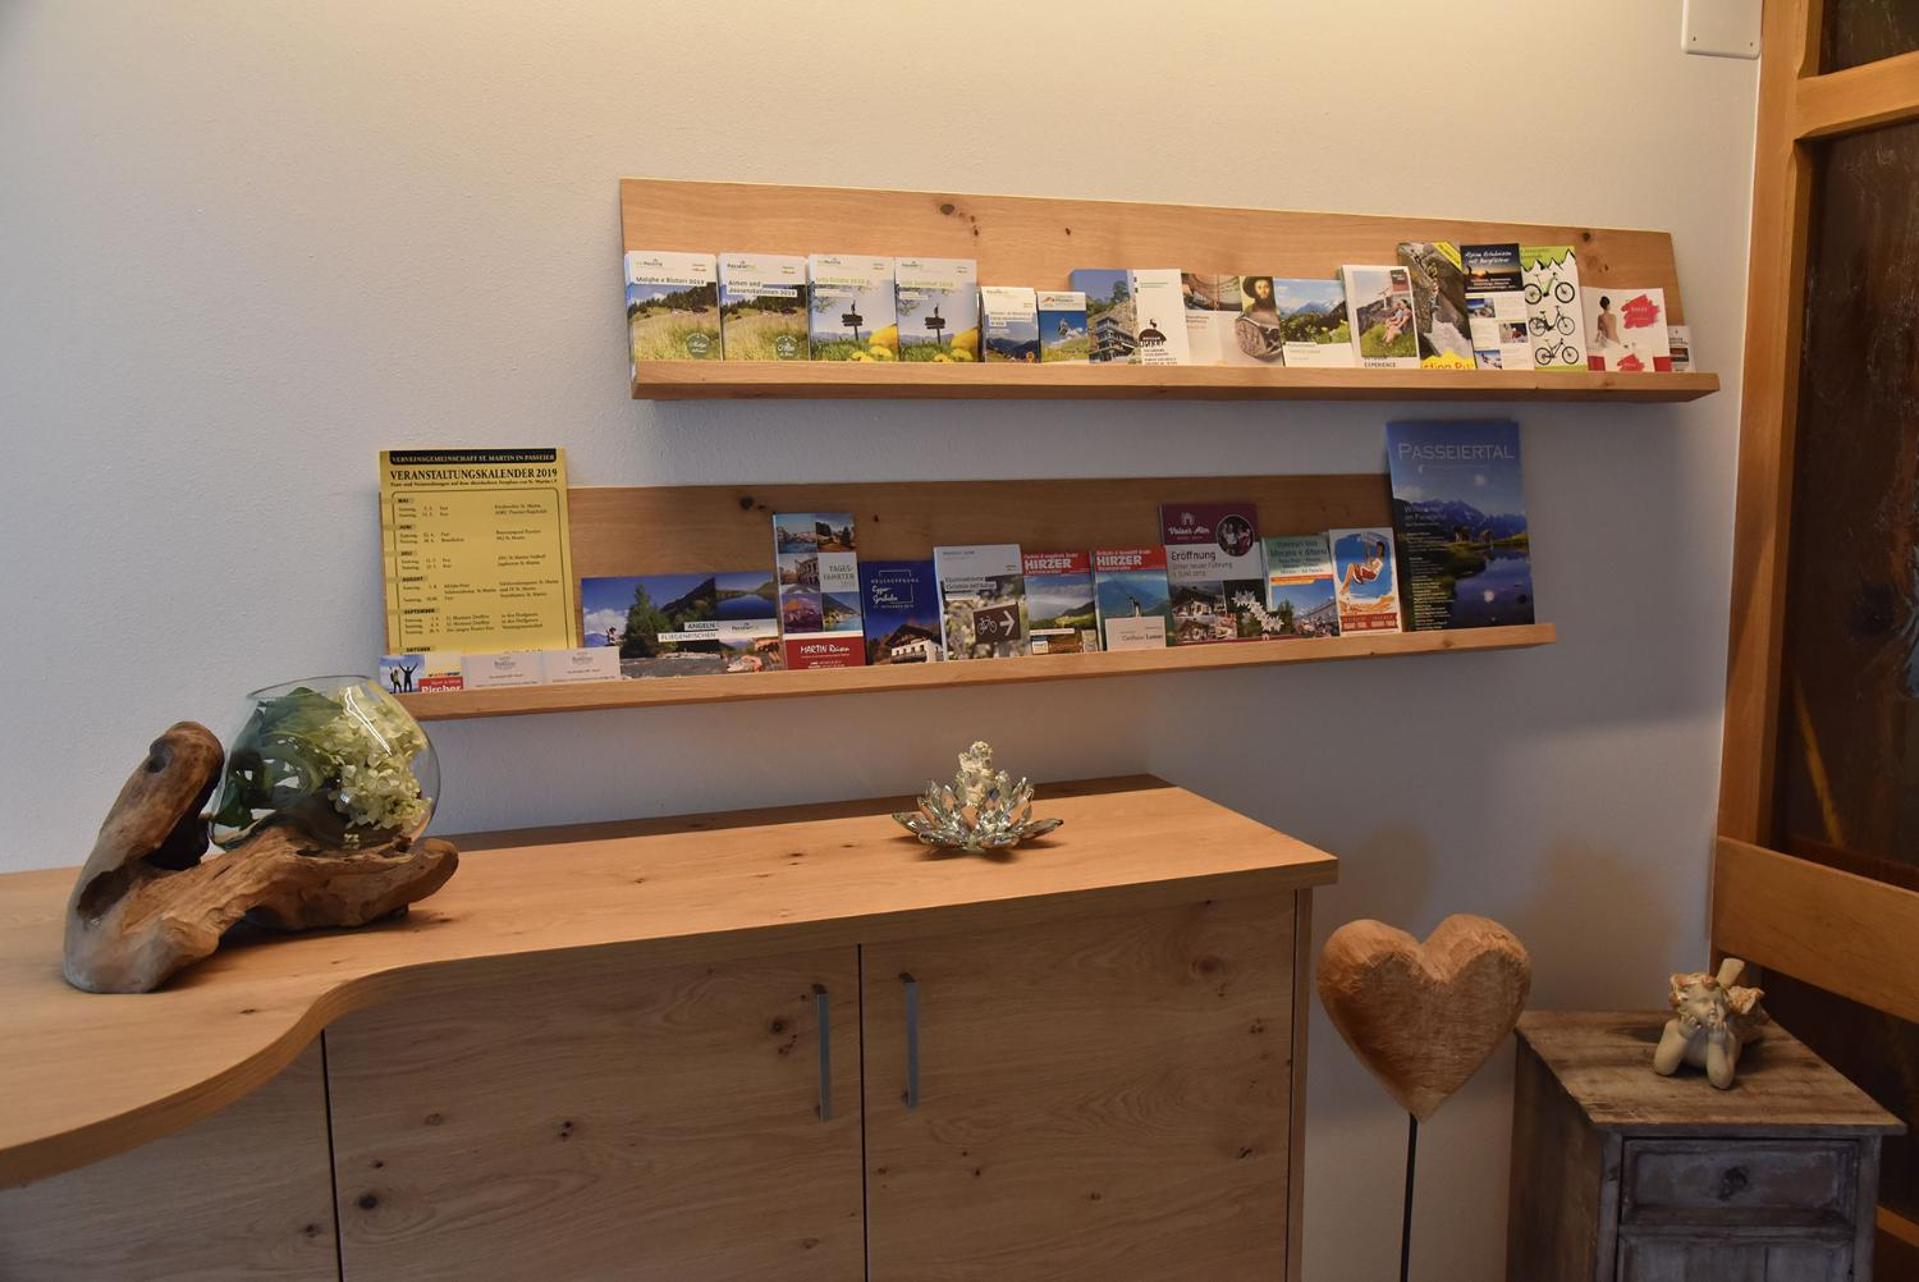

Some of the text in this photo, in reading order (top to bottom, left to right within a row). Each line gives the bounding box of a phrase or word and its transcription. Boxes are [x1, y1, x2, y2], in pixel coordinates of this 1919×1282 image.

[1398, 443, 1515, 460] PASSEIERTAL
[524, 454, 555, 462] PASSEIER
[390, 468, 557, 480] VERANSTALTUNGSKALENDER 2019
[1096, 555, 1142, 567] HIRZER
[1171, 551, 1217, 561] Eröffnung
[1024, 558, 1073, 570] HIRZER
[687, 622, 717, 630] ANGELN
[800, 644, 828, 655] MARTIN
